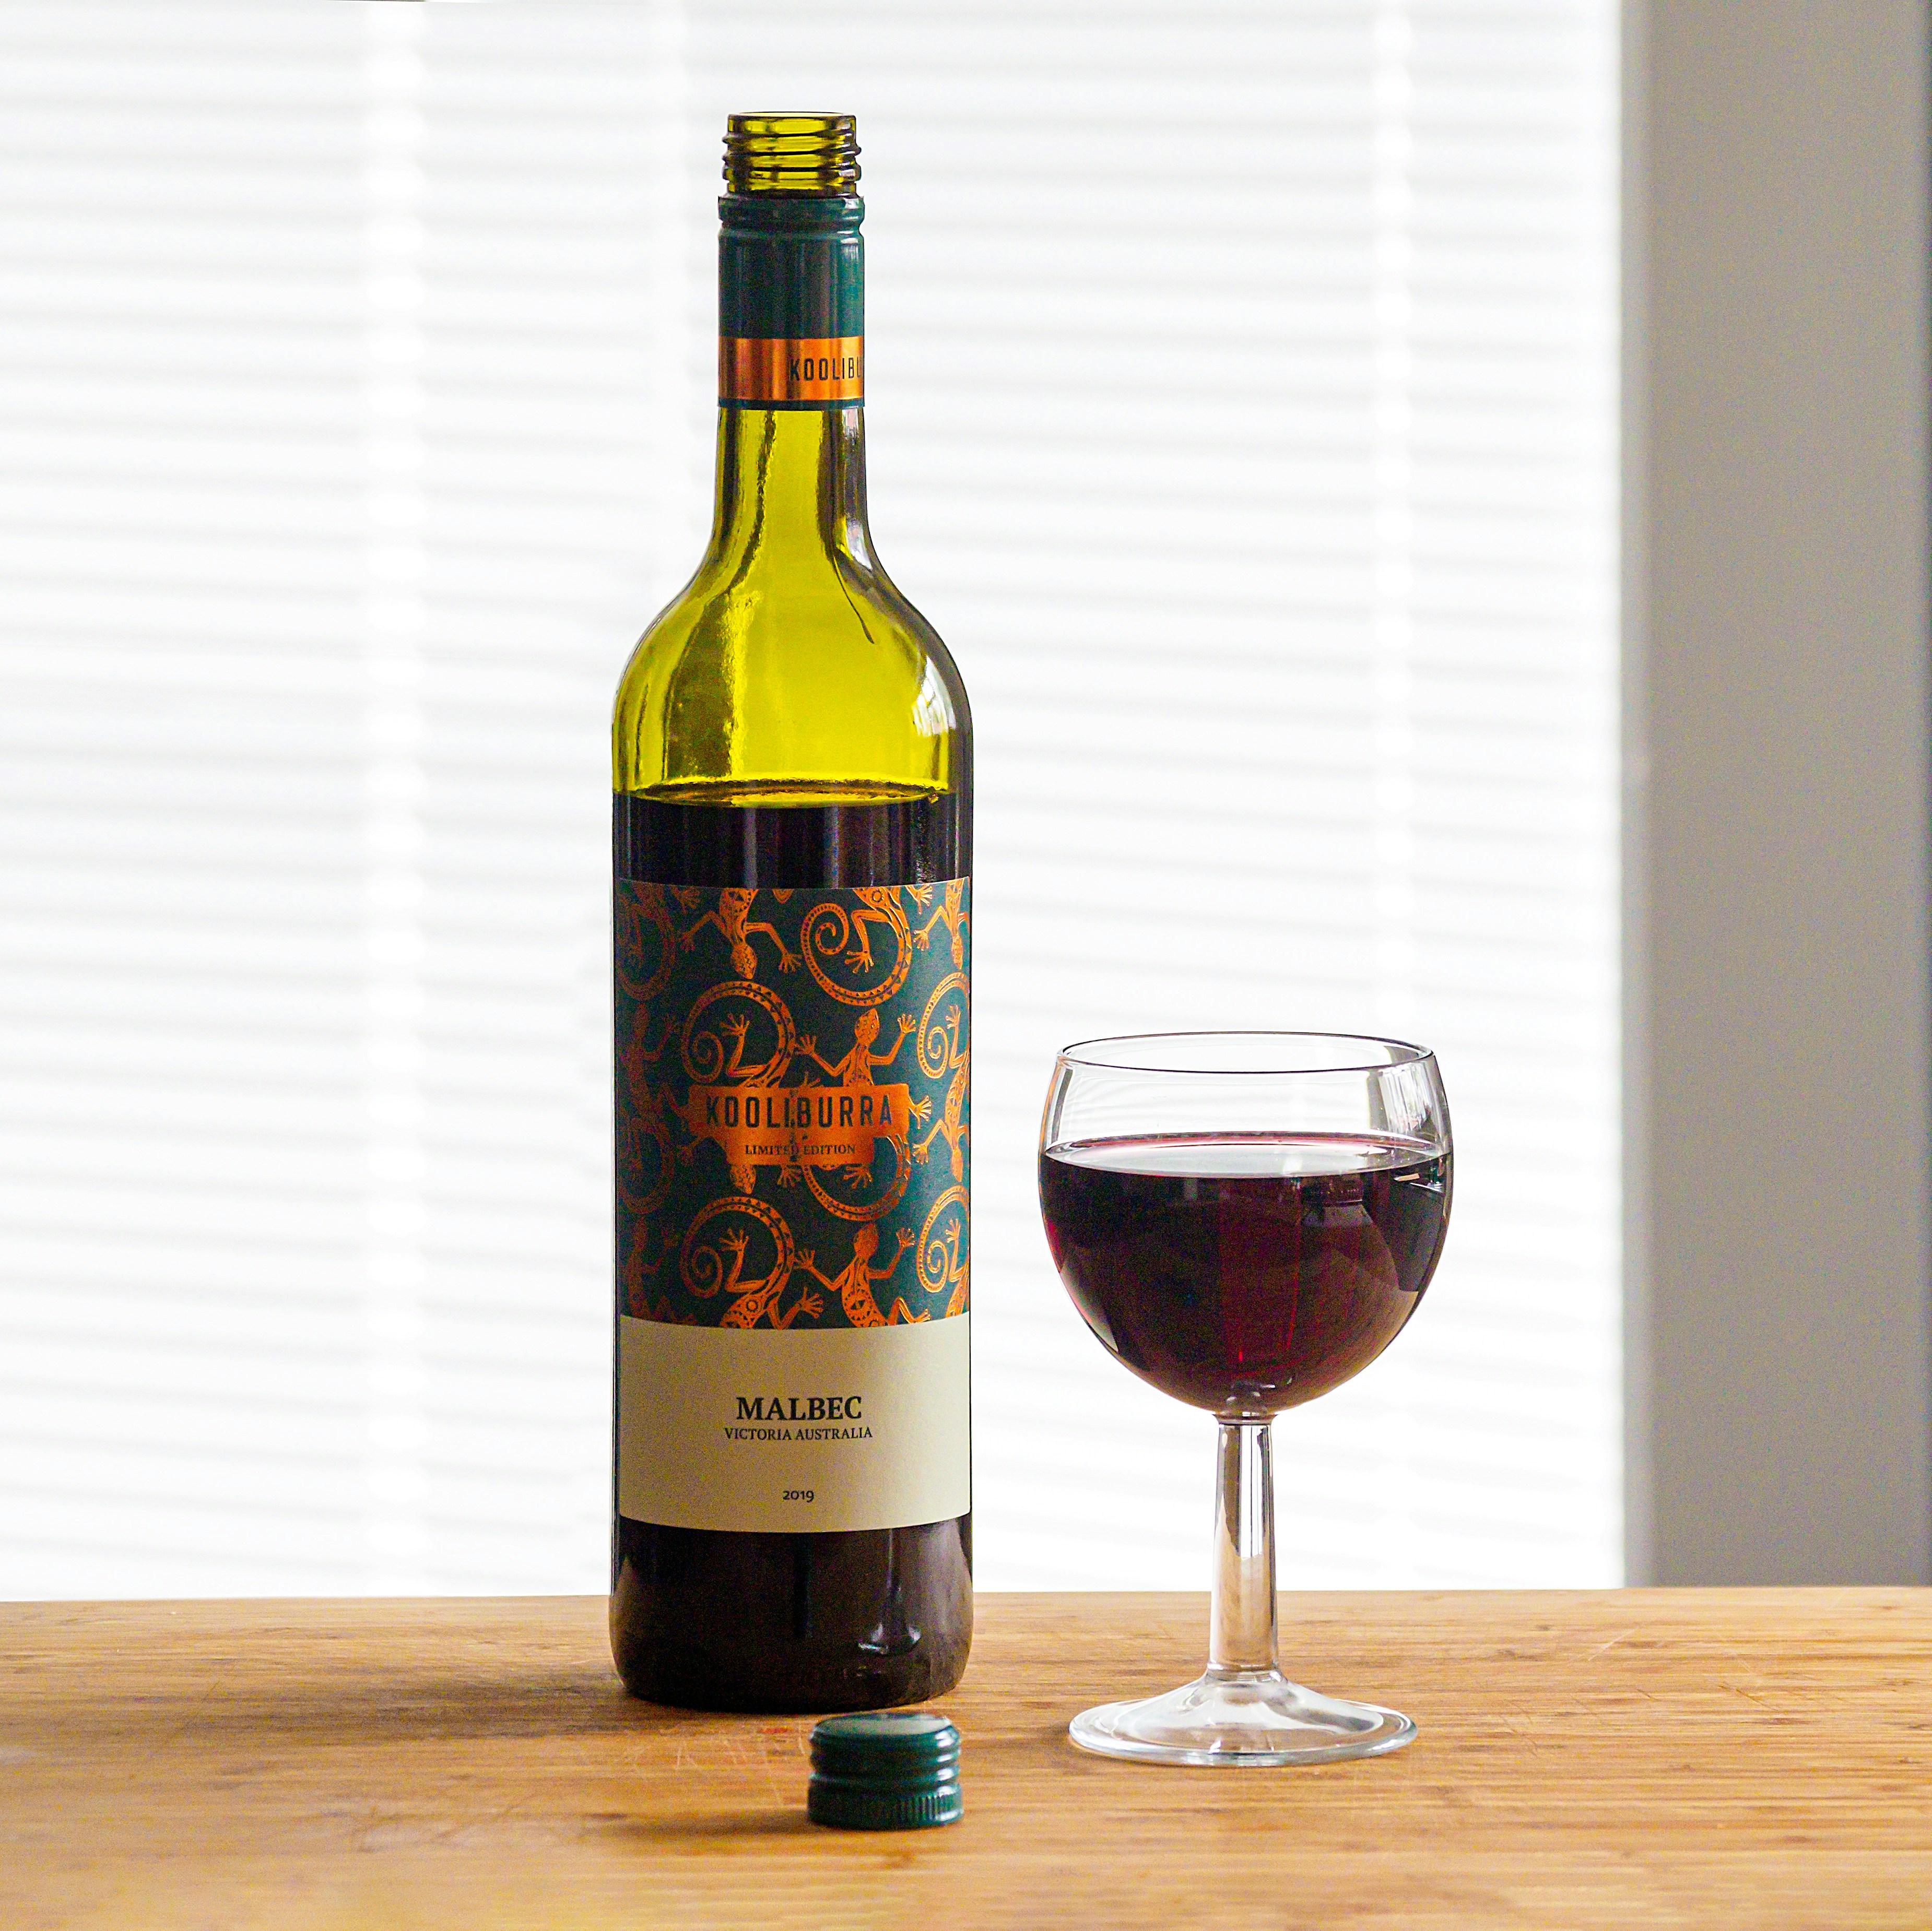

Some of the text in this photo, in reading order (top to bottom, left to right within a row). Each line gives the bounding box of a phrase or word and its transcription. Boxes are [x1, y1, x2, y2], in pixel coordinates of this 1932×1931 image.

[706, 1095, 892, 1128] KOOLIBURRA
[745, 1144, 856, 1155] LIMITED EDITION
[736, 1396, 862, 1420] MALBEC
[725, 1426, 873, 1440] VICTORIA AUSTRALIA
[783, 1490, 815, 1502] 2019
